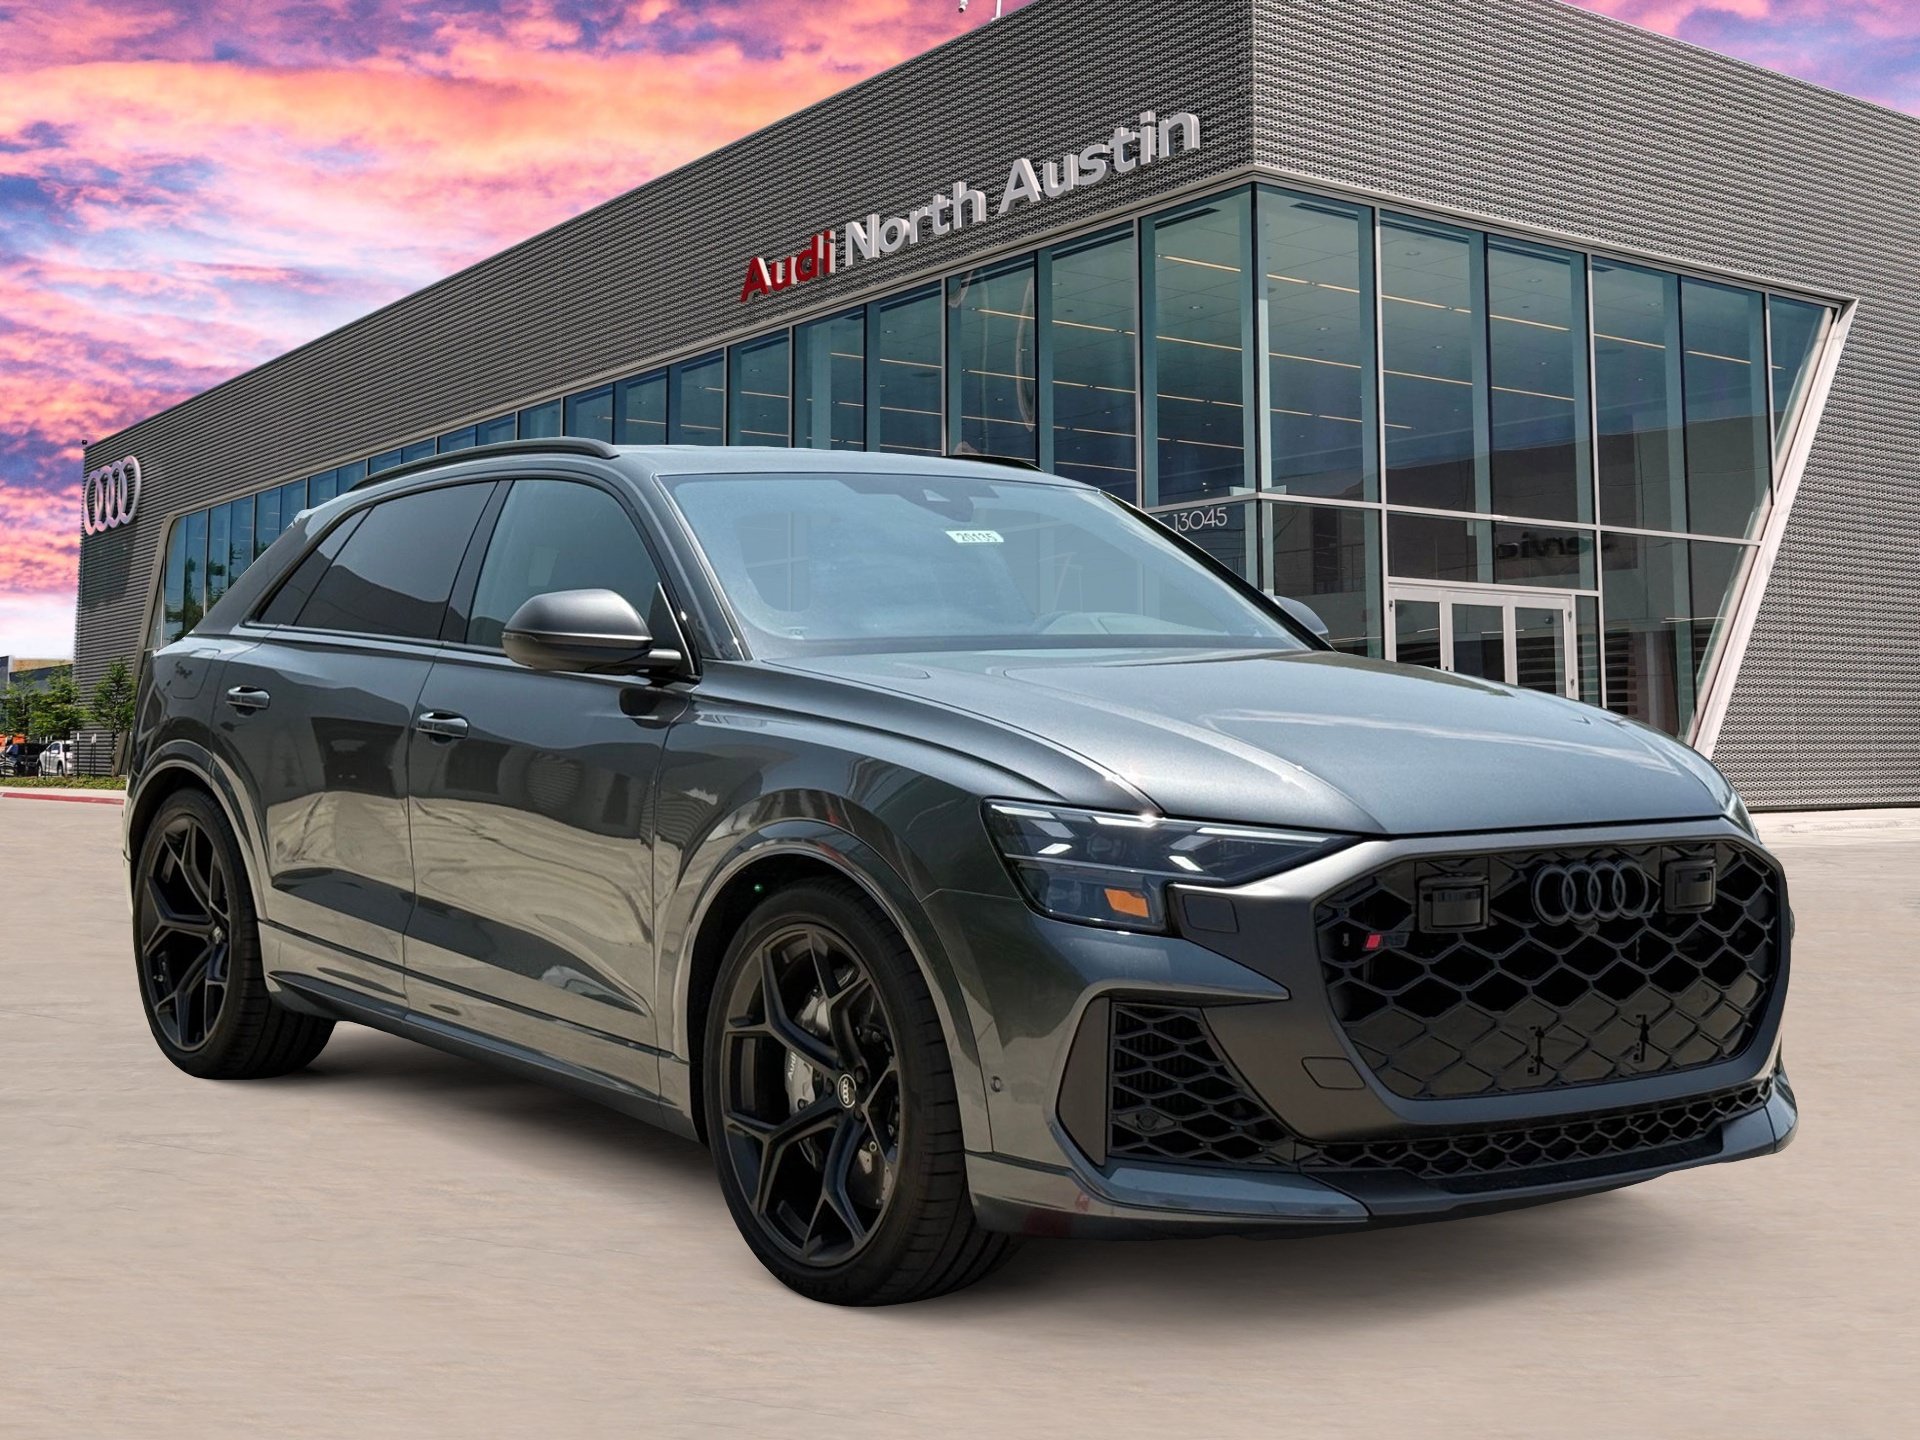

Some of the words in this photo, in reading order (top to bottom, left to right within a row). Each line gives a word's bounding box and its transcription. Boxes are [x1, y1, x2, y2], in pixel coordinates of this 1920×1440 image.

[741, 229, 836, 302] Audi
[844, 181, 987, 266] North
[999, 110, 1200, 213] Austin
[1173, 507, 1228, 532] 13045
[787, 1051, 797, 1082] Audi
